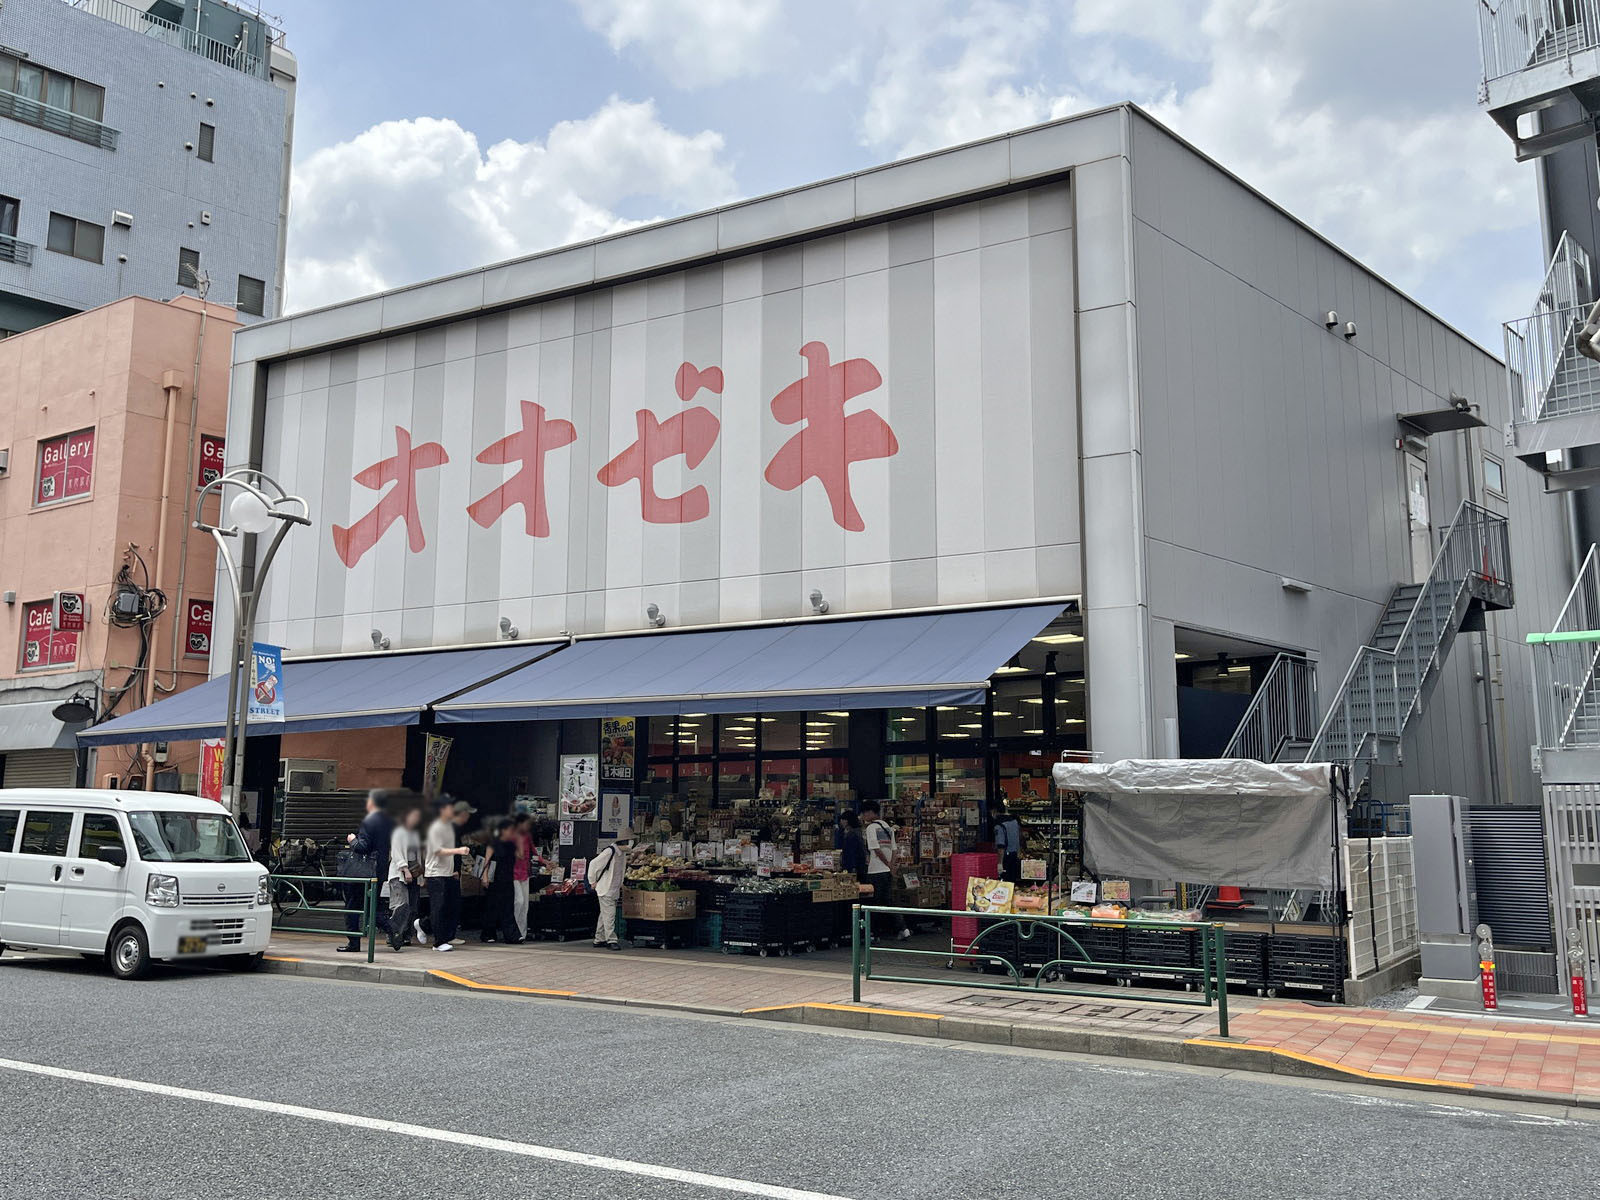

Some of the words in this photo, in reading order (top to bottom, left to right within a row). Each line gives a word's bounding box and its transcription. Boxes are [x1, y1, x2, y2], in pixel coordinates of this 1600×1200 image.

[44, 440, 91, 464] Gallery
[332, 341, 899, 568] オオゼキ
[29, 608, 53, 627] Cafe
[258, 655, 275, 666] NO!
[249, 707, 281, 716] STREET
[610, 766, 631, 778] 木曜日
